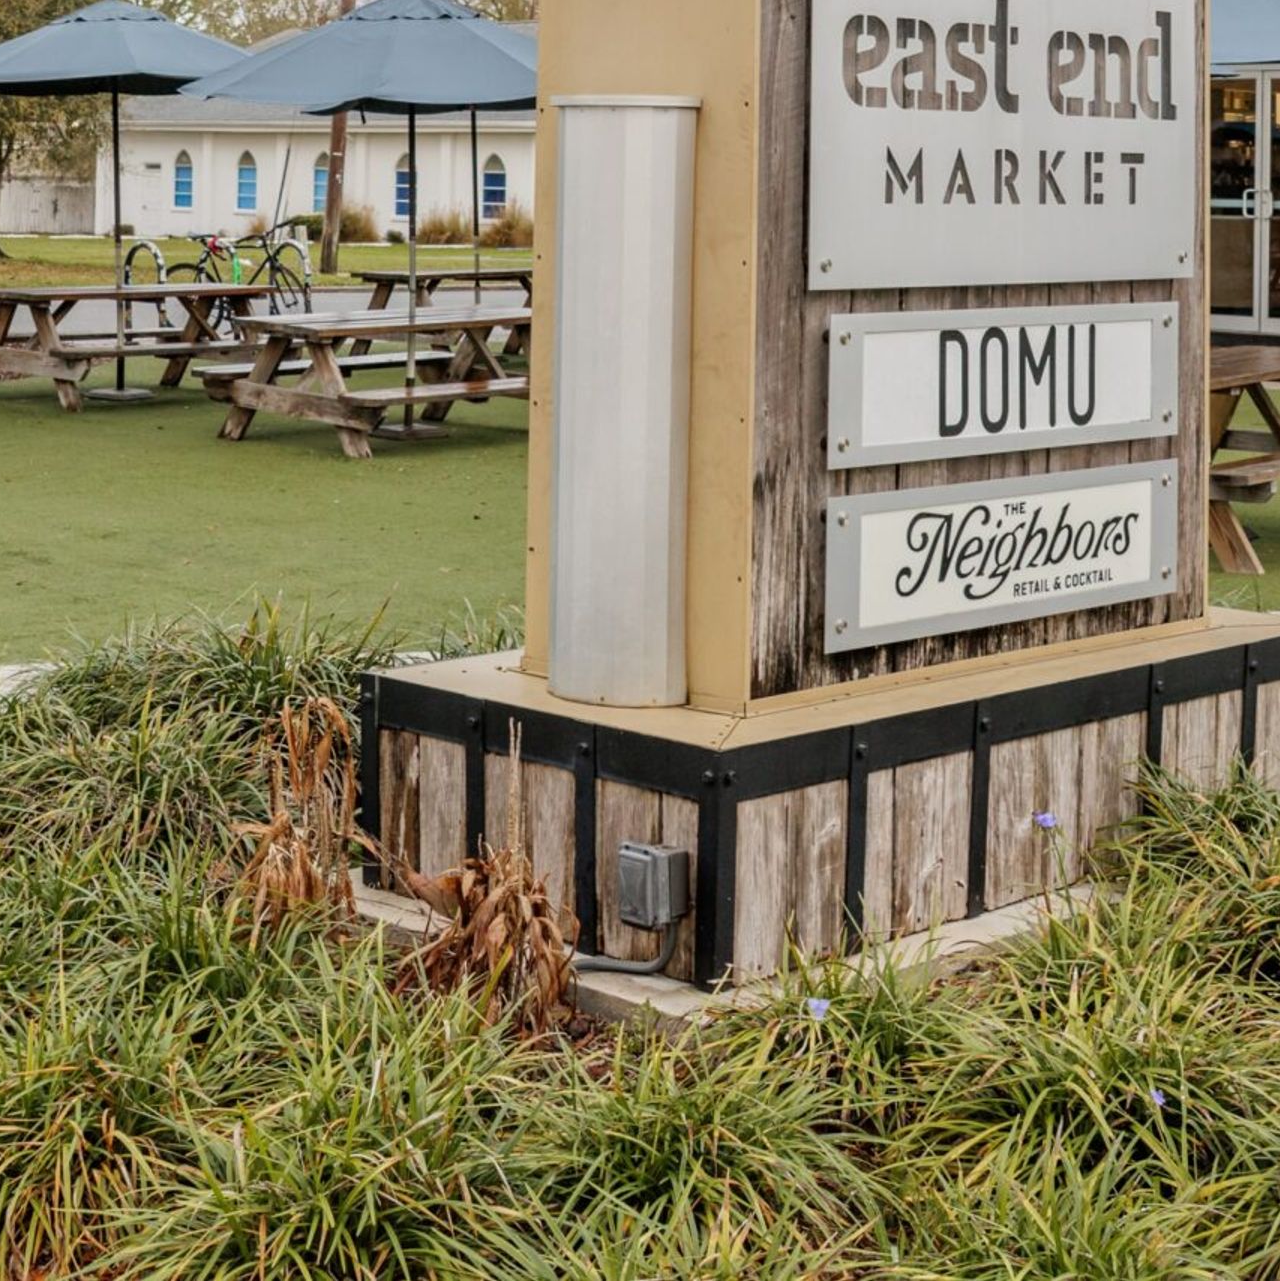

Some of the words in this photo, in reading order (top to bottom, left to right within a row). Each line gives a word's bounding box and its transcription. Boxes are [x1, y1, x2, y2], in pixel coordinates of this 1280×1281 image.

[1047, 11, 1177, 120] end
[884, 145, 1145, 205] MARKET
[939, 323, 1096, 437] DOMU
[1004, 502, 1027, 516] THE
[895, 502, 1139, 600] Neighbors
[1013, 579, 1050, 597] RETAIL
[1053, 577, 1062, 590] &
[1065, 568, 1113, 588] COCKTAIL
